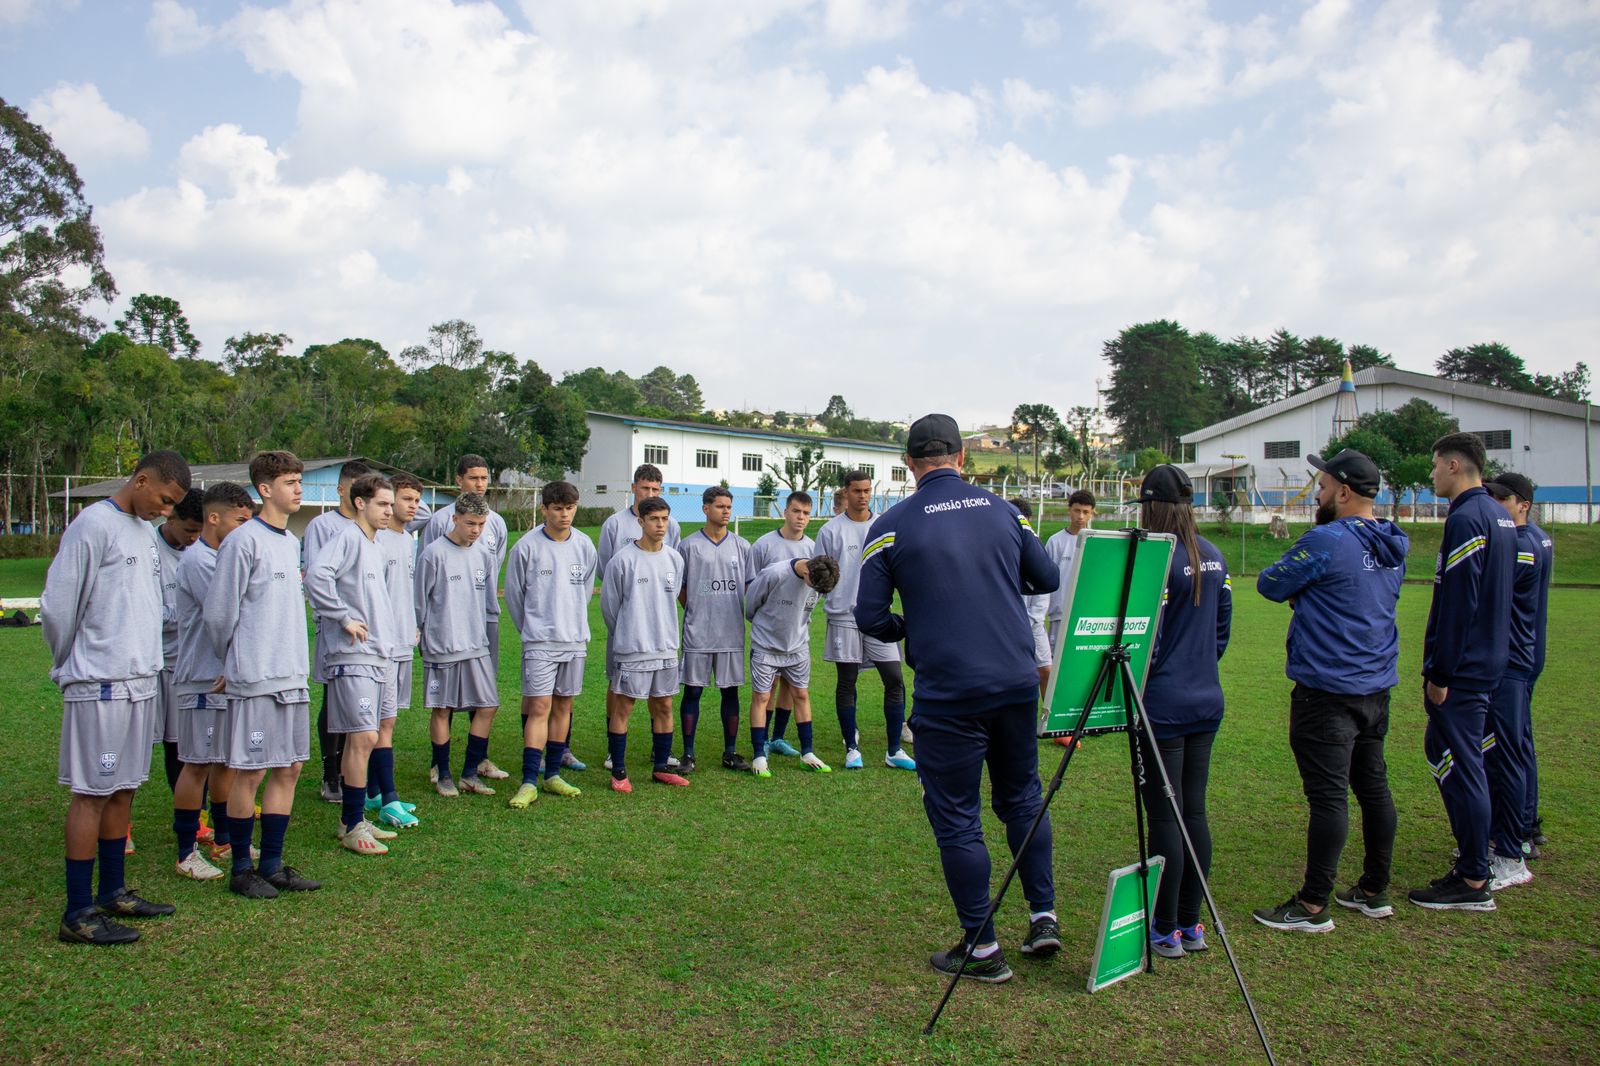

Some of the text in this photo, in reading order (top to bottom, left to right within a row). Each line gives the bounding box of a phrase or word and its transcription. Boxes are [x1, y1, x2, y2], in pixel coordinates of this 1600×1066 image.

[924, 497, 991, 514] COMISSÃO TÉCNICA
[711, 579, 737, 591] OTG
[1078, 619, 1147, 634] Magnus ports
